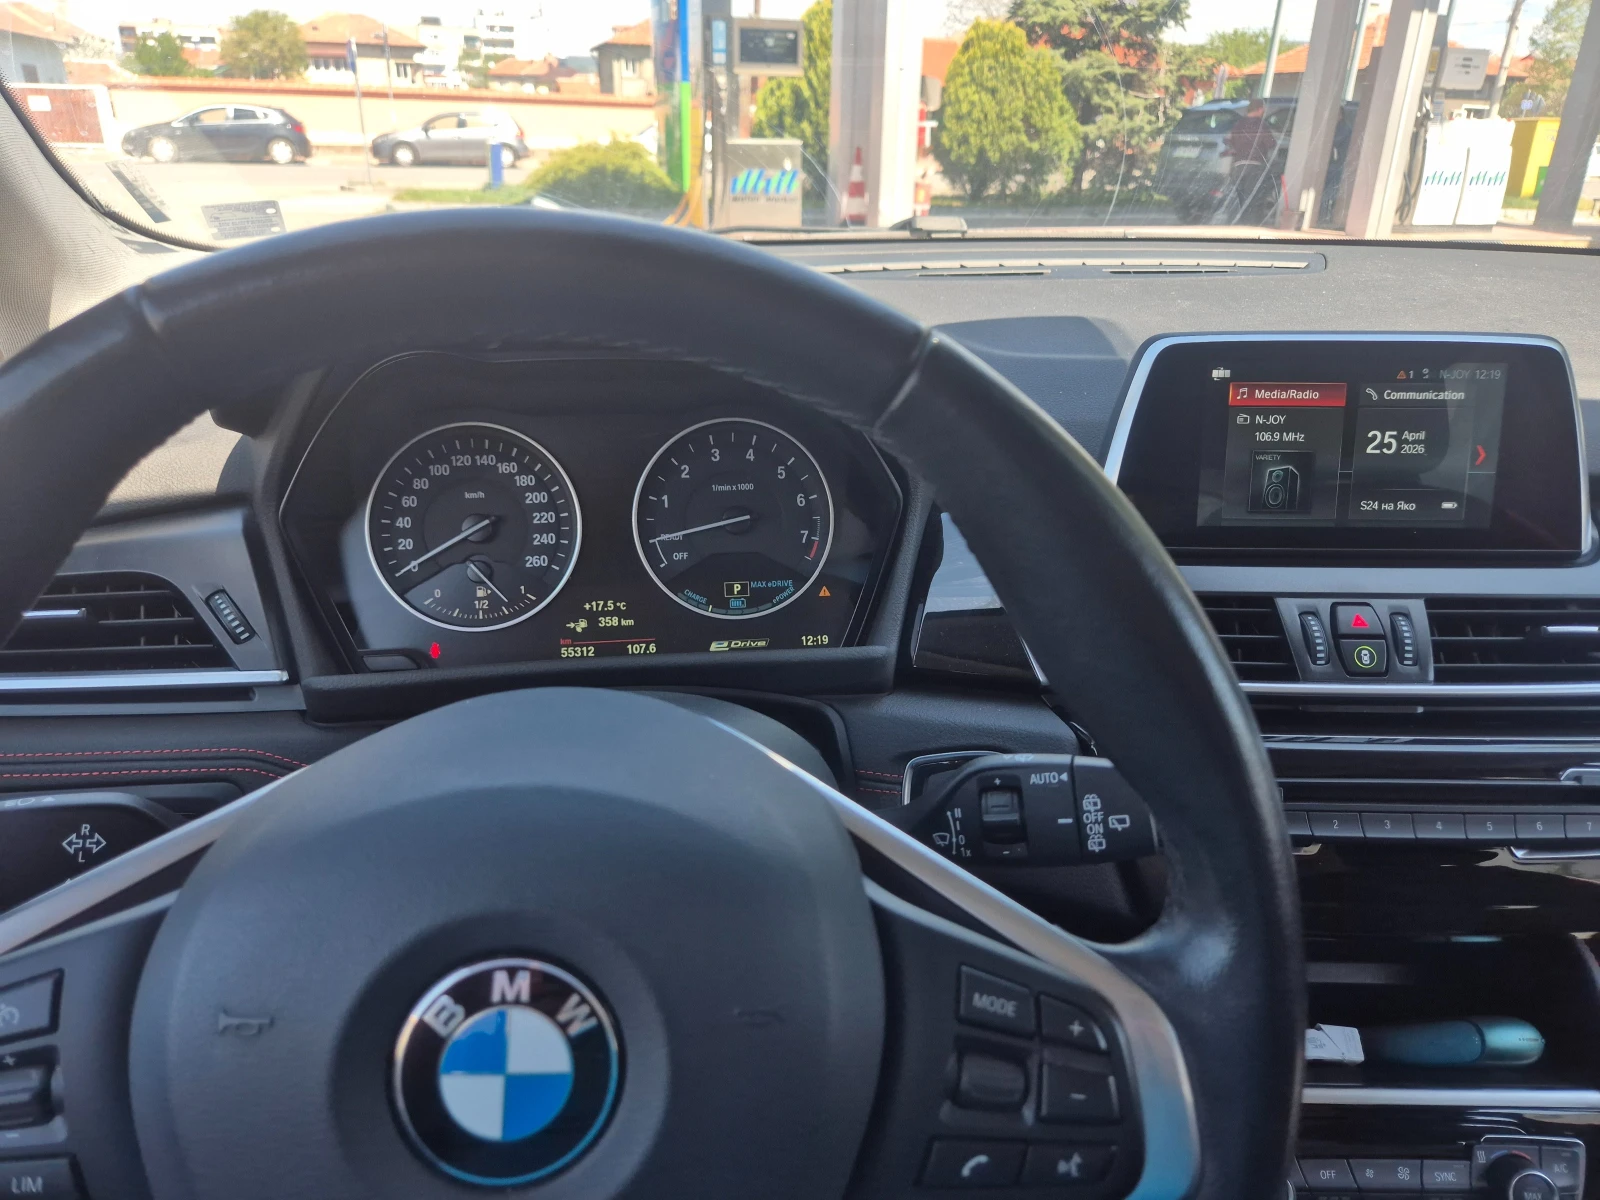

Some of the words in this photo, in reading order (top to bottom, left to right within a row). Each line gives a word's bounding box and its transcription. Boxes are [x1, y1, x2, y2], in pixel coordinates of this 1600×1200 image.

[1440, 370, 1470, 379] N-JOY
[1475, 370, 1500, 379] 12:19
[1254, 389, 1319, 400] Media/Radio
[1384, 390, 1464, 400] Communication
[1255, 414, 1286, 424] N-JOY
[1254, 432, 1280, 442] 106.9
[1282, 432, 1304, 442] MHz
[1402, 430, 1426, 441] April
[1366, 430, 1398, 454] 25
[1400, 444, 1424, 454] 2026
[475, 455, 496, 466] 140
[711, 449, 720, 461] 3
[746, 449, 754, 461] 4
[451, 456, 472, 466] 120
[428, 464, 450, 476] 100
[496, 462, 518, 474] 160
[680, 465, 690, 478] 2
[777, 466, 786, 479] 5
[413, 478, 429, 489] 80
[514, 475, 535, 486] 180
[402, 496, 417, 507] 60
[525, 492, 548, 504] 200
[662, 496, 668, 508] 1
[796, 494, 806, 506] 6
[1360, 501, 1379, 510] S24
[1396, 501, 1416, 511] Яко
[396, 517, 411, 528] 40
[533, 512, 555, 523] 220
[533, 534, 556, 544] 240
[800, 531, 808, 543] 7
[398, 539, 413, 550] 20
[525, 556, 548, 567] 260
[434, 589, 441, 598] 0
[520, 586, 525, 594] 1
[734, 584, 741, 595] P
[684, 589, 707, 604] CHARGE
[474, 600, 489, 609] 1/2
[584, 600, 614, 611] +17.5
[616, 602, 626, 610] °C
[598, 616, 618, 626] 358
[801, 635, 828, 646] 12:19
[561, 646, 595, 657] 55312
[627, 643, 656, 654] 107.6
[1030, 772, 1059, 785] AUTO
[1083, 812, 1104, 823] OFF
[81, 824, 90, 836] R
[1087, 823, 1104, 834] ON
[1332, 819, 1339, 829] 2
[1384, 820, 1390, 829] 3
[1436, 820, 1442, 830] 4
[1486, 821, 1493, 831] 5
[1536, 821, 1543, 831] 6
[1587, 822, 1592, 831] 7
[78, 851, 86, 863] L
[423, 970, 598, 1038] BMW
[972, 992, 1017, 1018] MODE
[1554, 1164, 1568, 1173] A/C
[1320, 1170, 1336, 1180] OFF
[1434, 1172, 1457, 1182] SYNC
[11, 1176, 43, 1193] LIM
